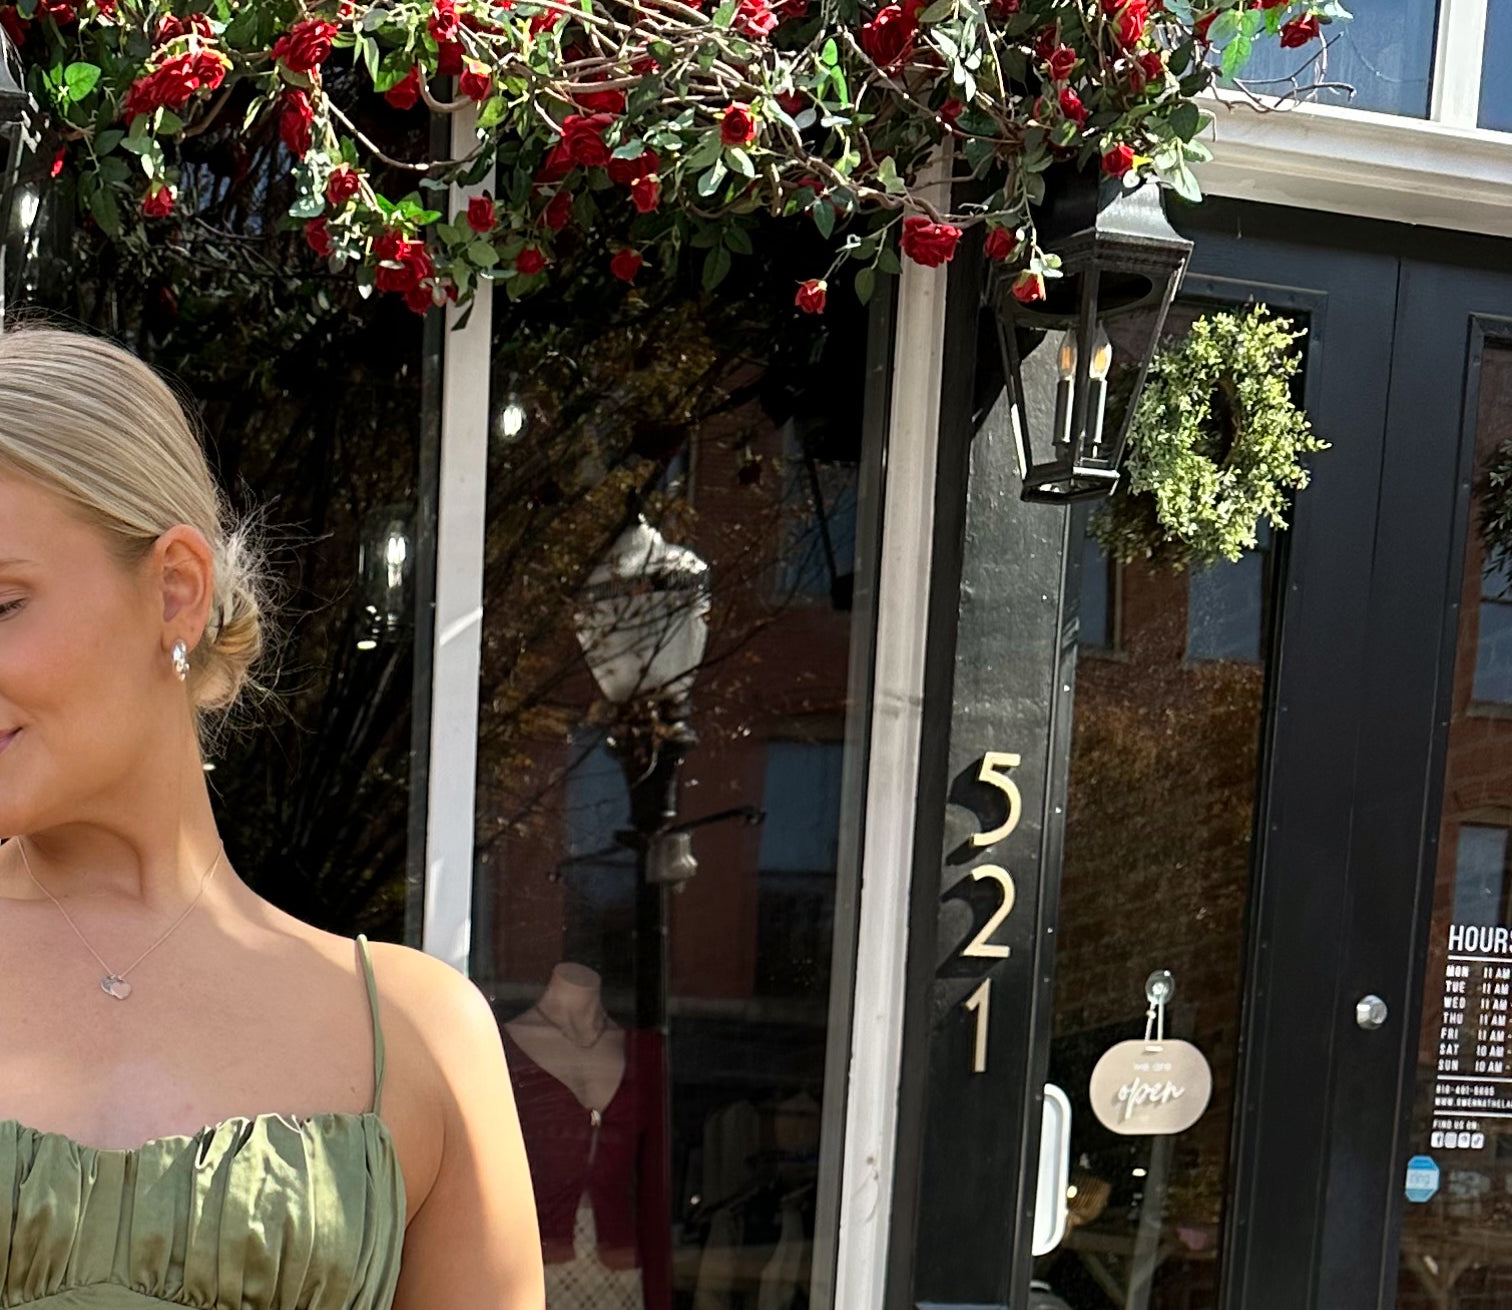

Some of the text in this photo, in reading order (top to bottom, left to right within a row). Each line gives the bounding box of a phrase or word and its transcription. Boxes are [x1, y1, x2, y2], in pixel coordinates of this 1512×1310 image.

[962, 751, 1022, 1073] 521
[1448, 924, 1512, 954] HOUR
[1445, 964, 1511, 980] MON 11 AM
[1445, 980, 1509, 996] TUE 11 AM
[1443, 996, 1508, 1011] WED 11 AM
[1443, 1011, 1506, 1027] THU 11 AM
[1440, 1027, 1459, 1040] FRI
[1477, 1028, 1487, 1041] 11
[1489, 1029, 1505, 1042] AM
[1439, 1042, 1460, 1056] SAT
[1476, 1044, 1487, 1057] 10
[1489, 1045, 1504, 1058] AM
[1133, 1063, 1149, 1071] we
[1437, 1058, 1459, 1072] SUN
[1474, 1060, 1486, 1073] 10
[1487, 1060, 1503, 1073] AM
[1117, 1076, 1185, 1120] open
